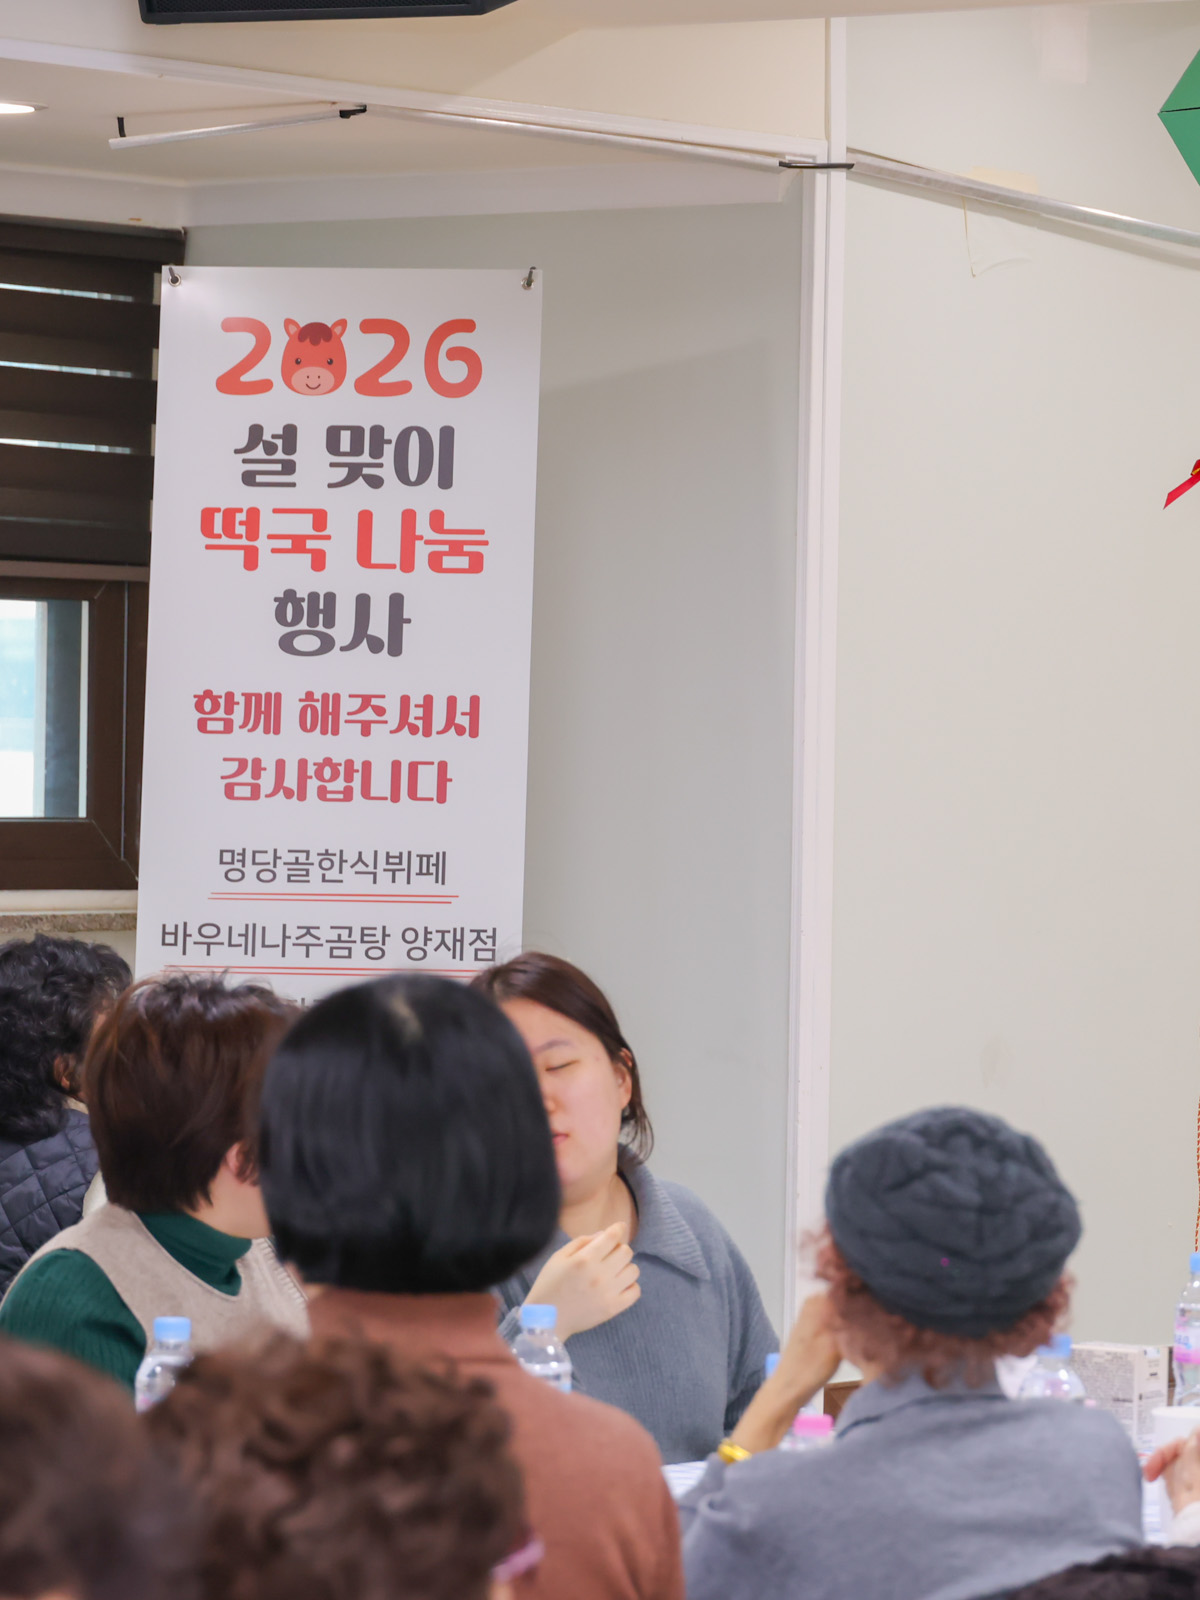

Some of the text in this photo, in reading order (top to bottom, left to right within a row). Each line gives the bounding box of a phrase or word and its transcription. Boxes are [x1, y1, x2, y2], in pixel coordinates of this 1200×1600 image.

[233, 423, 456, 490] 설 맞이
[199, 506, 490, 575] 떡국 나눔
[273, 588, 412, 658] 행사
[193, 689, 481, 739] 함께 해주셔서
[220, 757, 453, 805] 감사합니다
[218, 848, 447, 886] 명당골한식뷔페
[161, 921, 498, 962] 바우네나주곰탕 양재점
